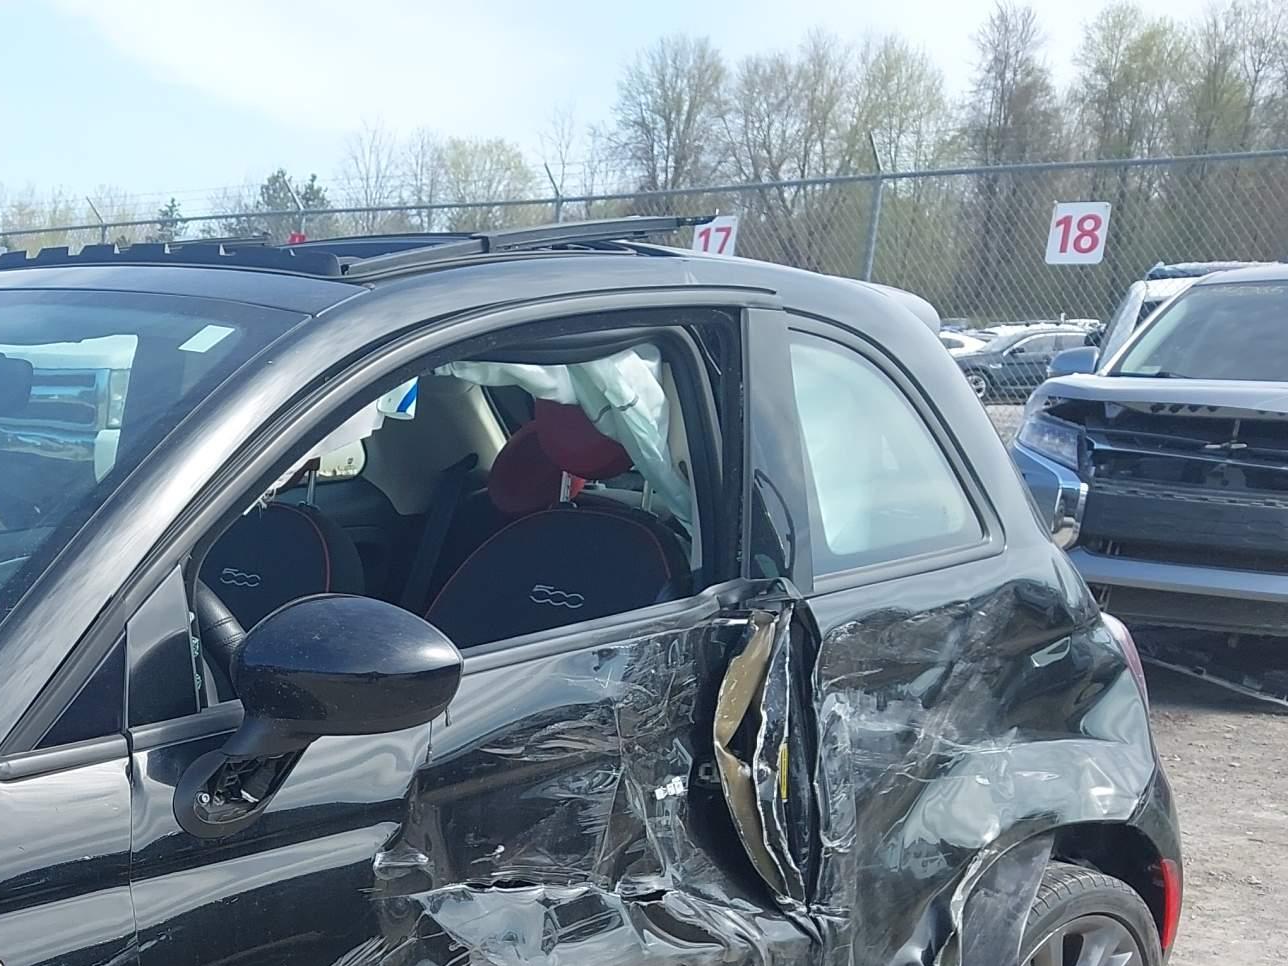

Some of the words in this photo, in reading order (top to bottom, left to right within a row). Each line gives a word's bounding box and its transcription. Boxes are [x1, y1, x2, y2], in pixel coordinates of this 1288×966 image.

[698, 226, 732, 254] 17
[1055, 214, 1102, 254] 18
[220, 567, 261, 588] 500
[529, 584, 585, 609] 500
